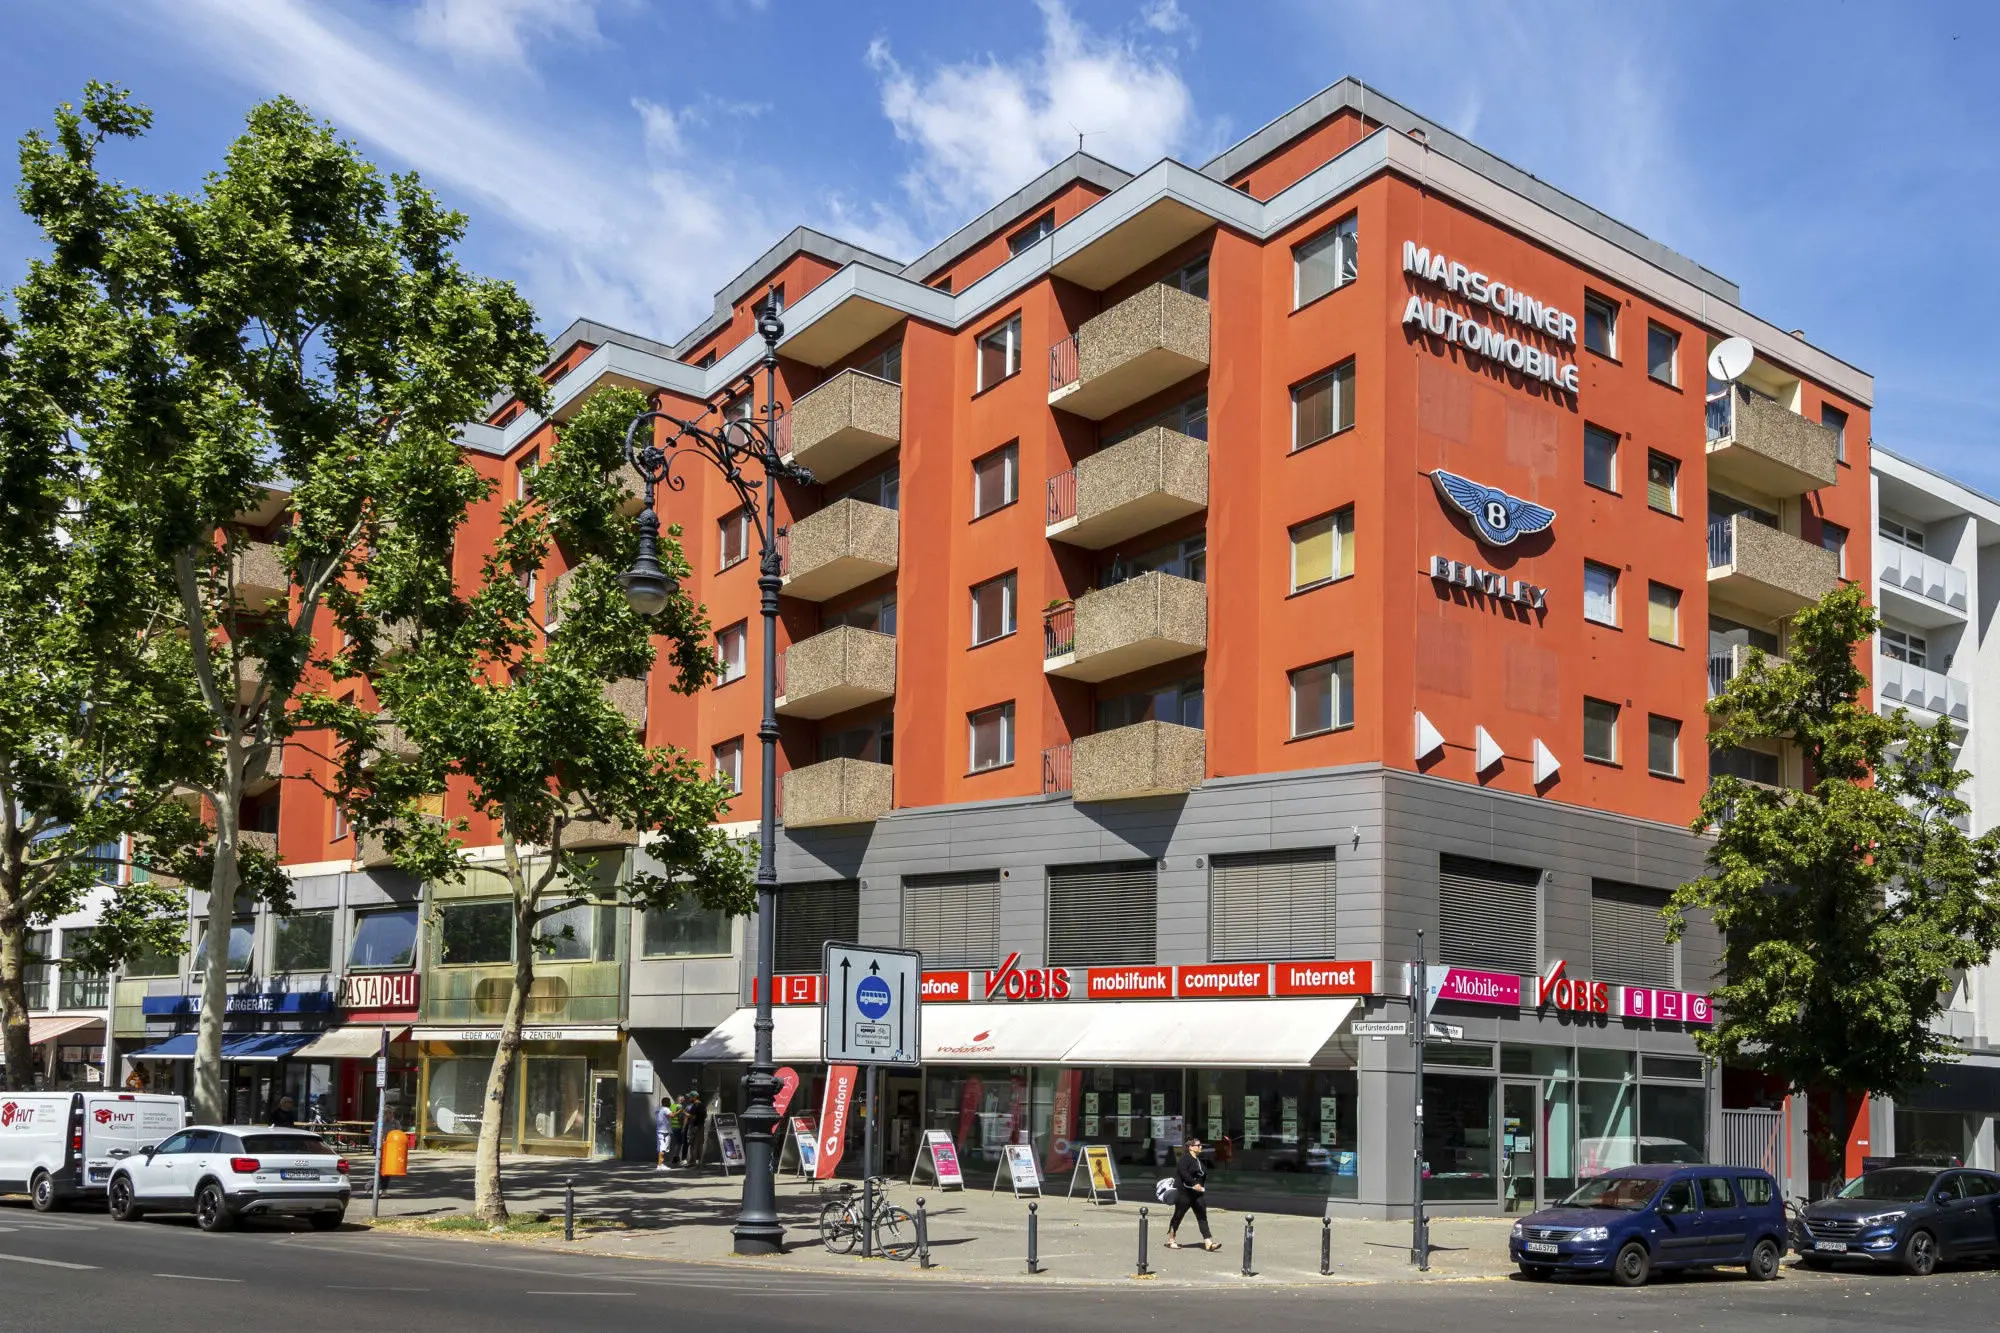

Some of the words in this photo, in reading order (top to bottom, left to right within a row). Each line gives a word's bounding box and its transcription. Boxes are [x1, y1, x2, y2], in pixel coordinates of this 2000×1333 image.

[1403, 240, 1577, 344] MARSCHNER
[1402, 295, 1579, 393] AUTOMOBILE
[1486, 501, 1507, 530] B
[1430, 555, 1549, 609] BENTLEY
[985, 951, 1070, 1001] VOBIS
[1092, 971, 1167, 991] mobilfunk
[1184, 970, 1261, 991] computer
[1290, 967, 1356, 987] Internet
[1536, 960, 1609, 1013] VOBIS
[338, 976, 379, 1007] PASTA
[382, 974, 415, 1006] DELI
[461, 1032, 482, 1040] LEDER
[529, 1031, 562, 1040] ZENTRUM
[1354, 1023, 1404, 1032] Kurfürstendamm
[937, 1045, 995, 1054] vodafone
[16, 1109, 34, 1123] HVT
[114, 1114, 135, 1122] HVT
[833, 1077, 848, 1135] vodafone
